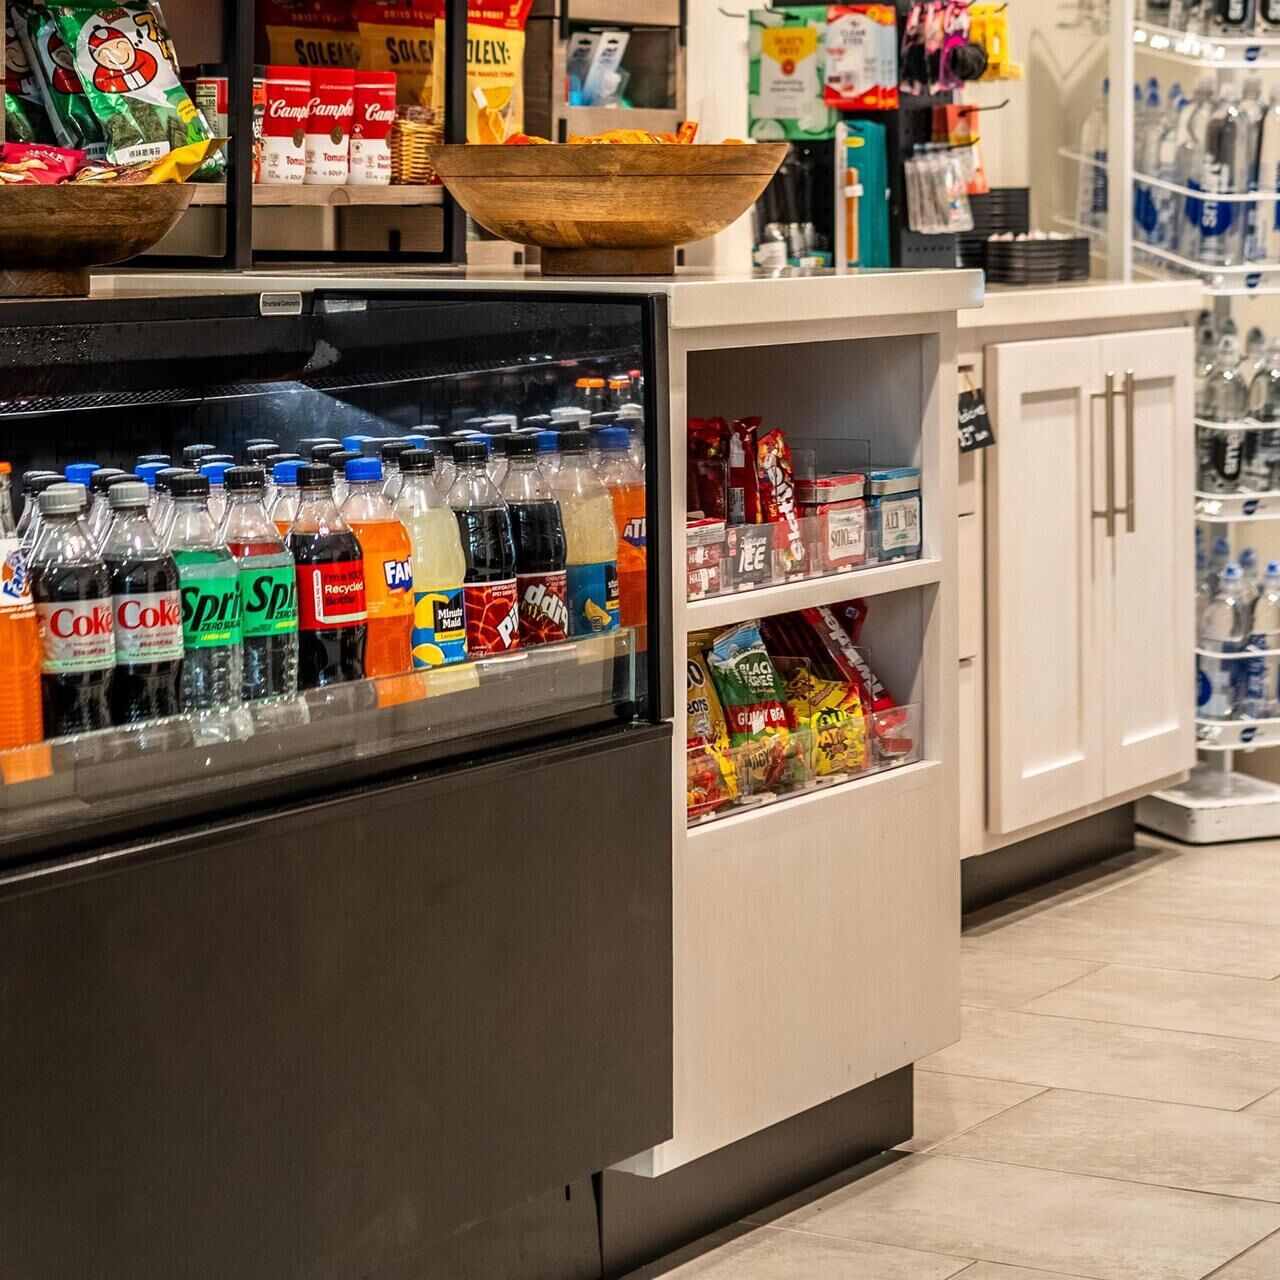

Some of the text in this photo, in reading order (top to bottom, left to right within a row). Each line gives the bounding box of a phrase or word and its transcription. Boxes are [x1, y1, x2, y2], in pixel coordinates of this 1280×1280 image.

[738, 546, 767, 573] ICE
[324, 580, 364, 595] Recycled
[117, 599, 181, 630] Coke
[437, 607, 463, 621] Minute
[49, 607, 113, 639] Coke
[201, 621, 222, 631] ZERO
[442, 618, 462, 629] Maid
